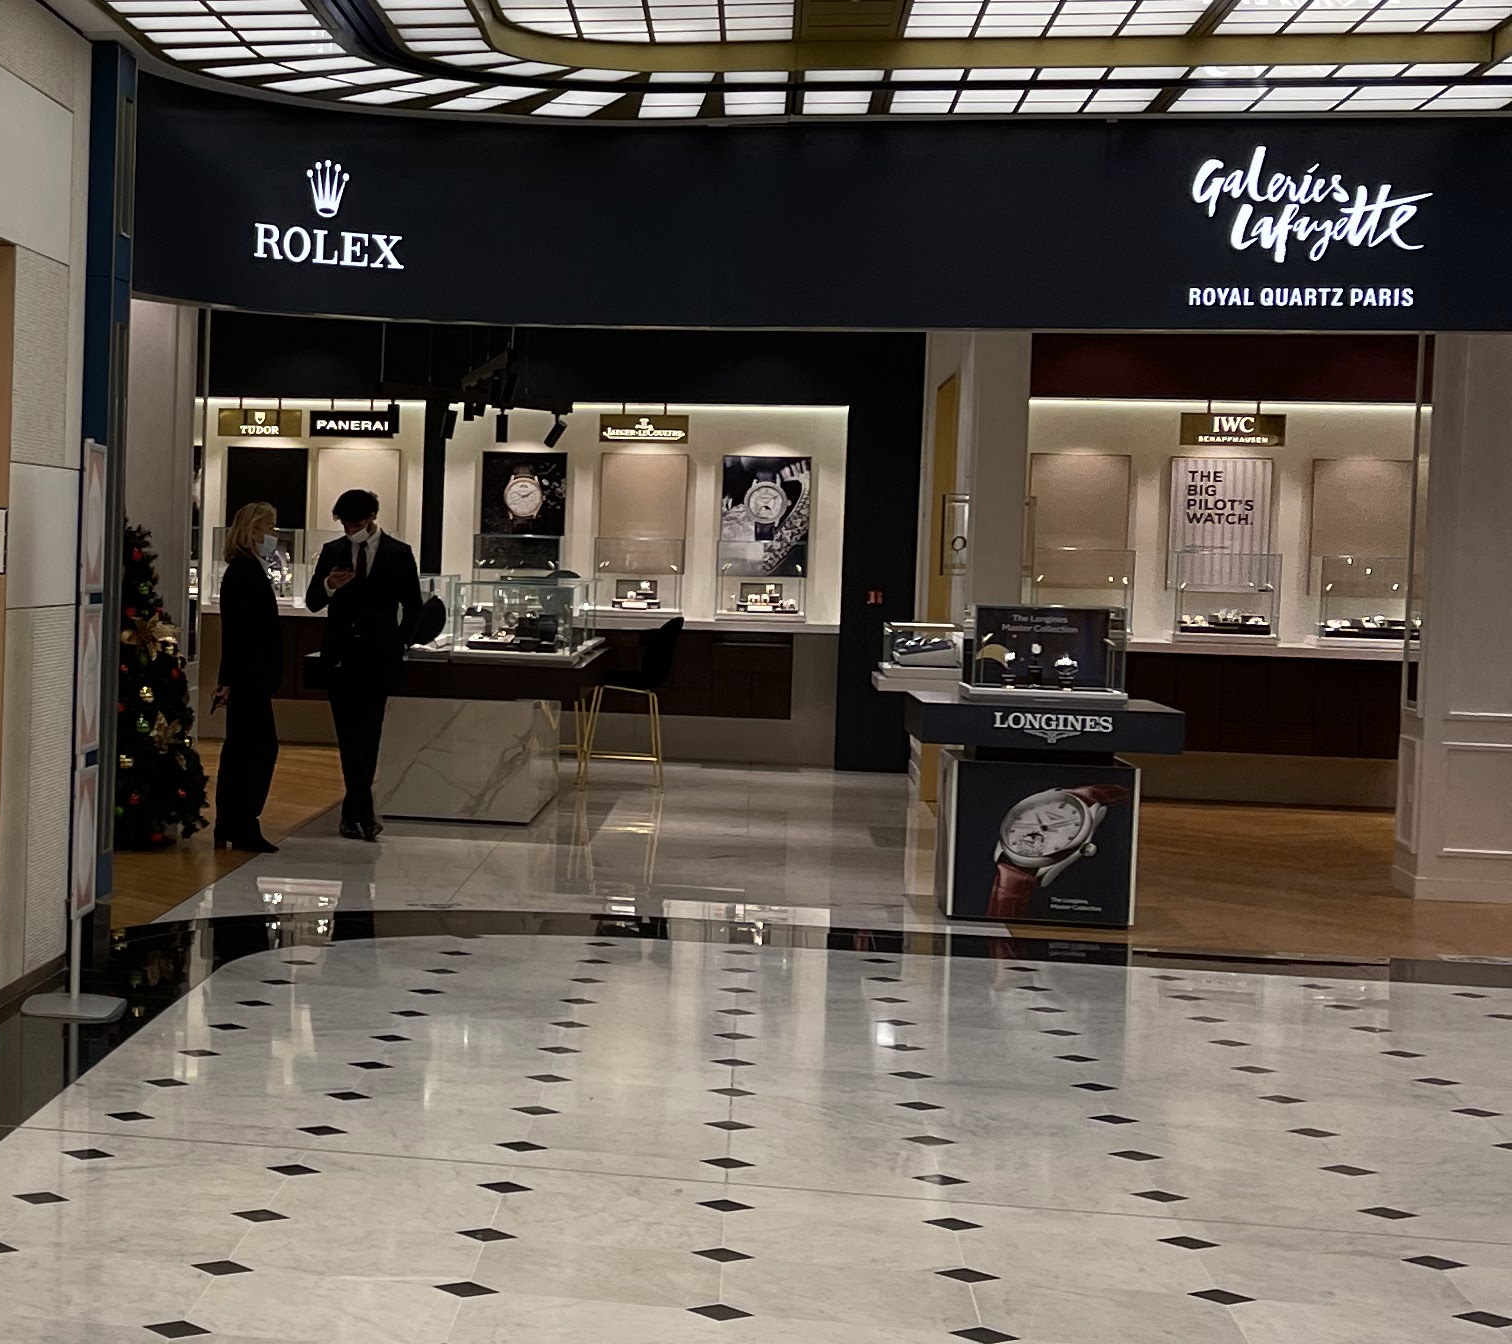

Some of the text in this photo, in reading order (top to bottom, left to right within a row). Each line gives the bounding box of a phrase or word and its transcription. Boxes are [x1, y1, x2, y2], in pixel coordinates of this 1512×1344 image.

[1191, 145, 1350, 218] Galeries
[1230, 184, 1433, 263] Lafayette
[253, 222, 405, 270] ROLEX
[1188, 287, 1414, 307] ROYAL QUARTZ PARIS
[239, 425, 280, 435] TUDOR
[1213, 416, 1255, 433] IWC
[1188, 470, 1224, 483] THE
[1187, 484, 1217, 497] BIG
[1186, 498, 1255, 512] PILOT'S
[1186, 511, 1254, 526] WATCH.
[1011, 613, 1029, 623] The
[994, 711, 1114, 733] LONGINES
